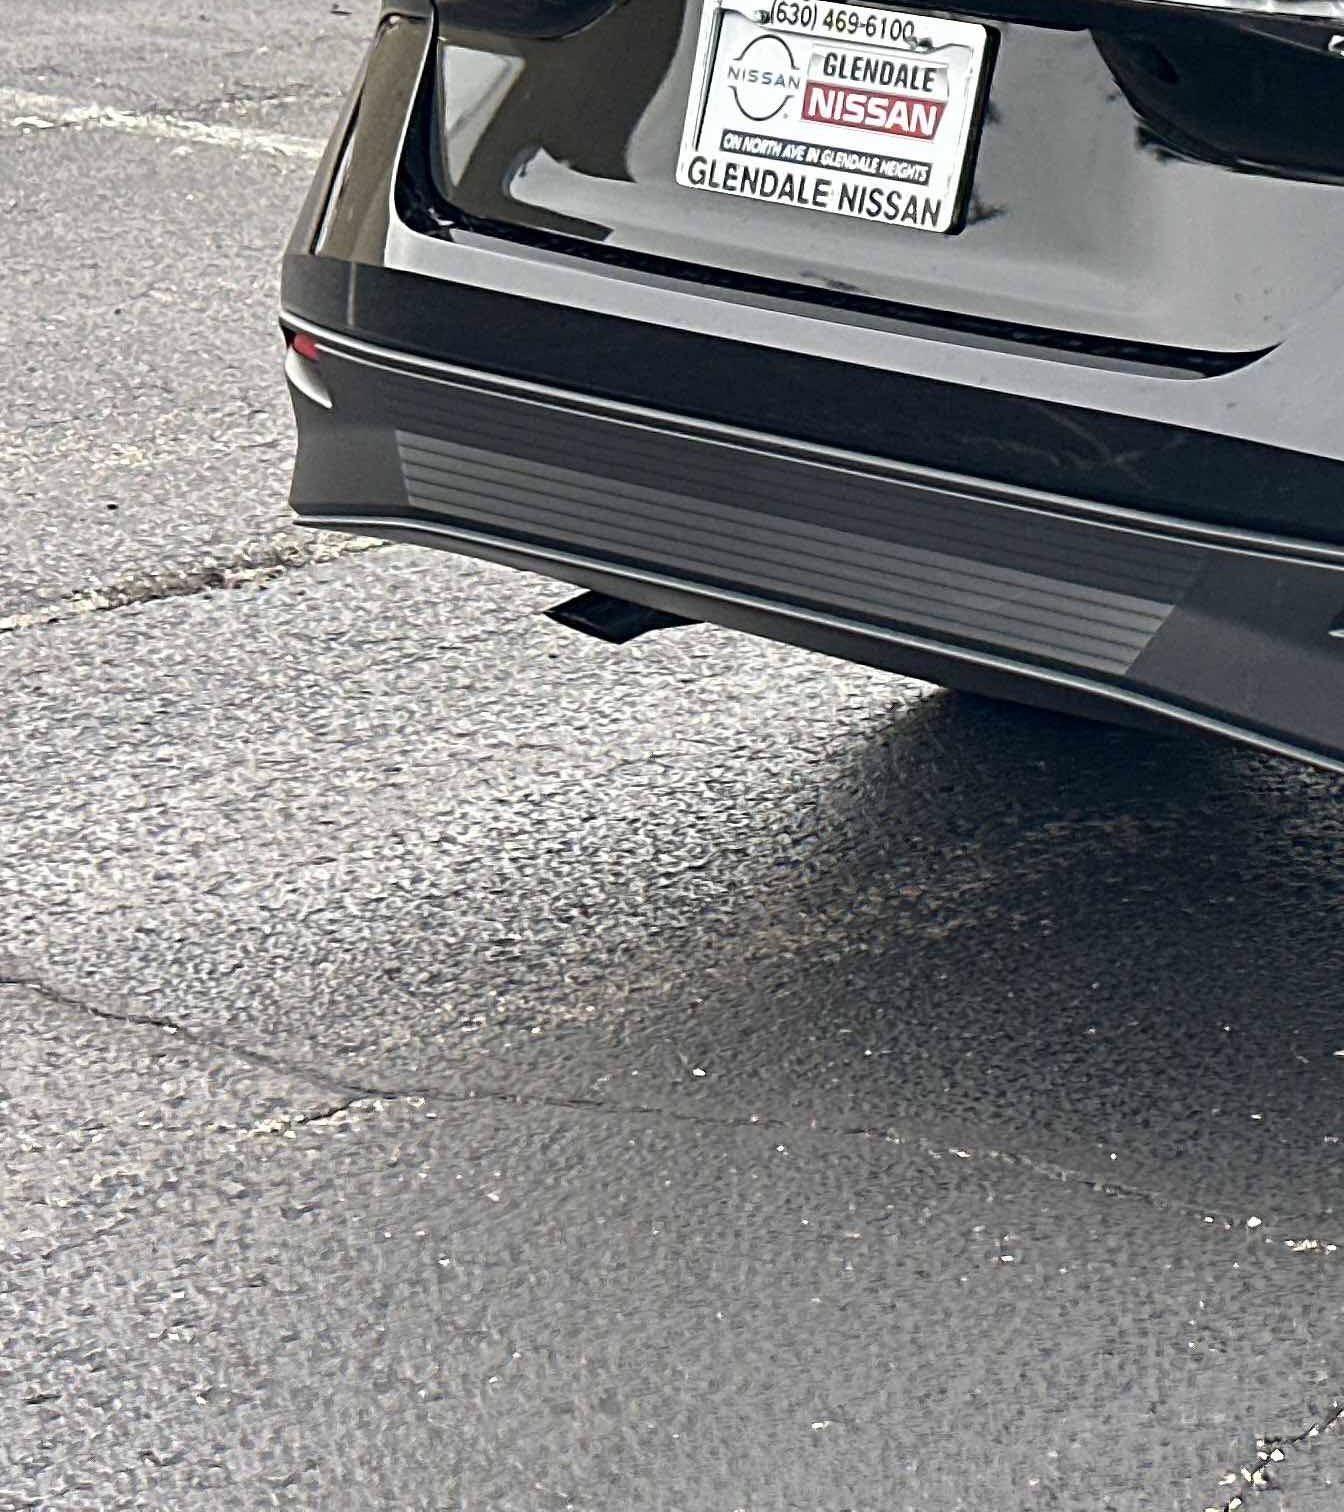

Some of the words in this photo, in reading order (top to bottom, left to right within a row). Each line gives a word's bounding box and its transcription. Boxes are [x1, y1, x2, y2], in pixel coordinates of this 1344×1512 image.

[822, 7, 915, 40] 469-6100
[728, 65, 800, 90] NISSAN
[823, 52, 937, 92] GLENDALE
[808, 88, 938, 136] NISSAN
[820, 149, 881, 175] GLENDALE
[688, 155, 834, 208] GLENDALE
[837, 182, 943, 228] NISSAN
